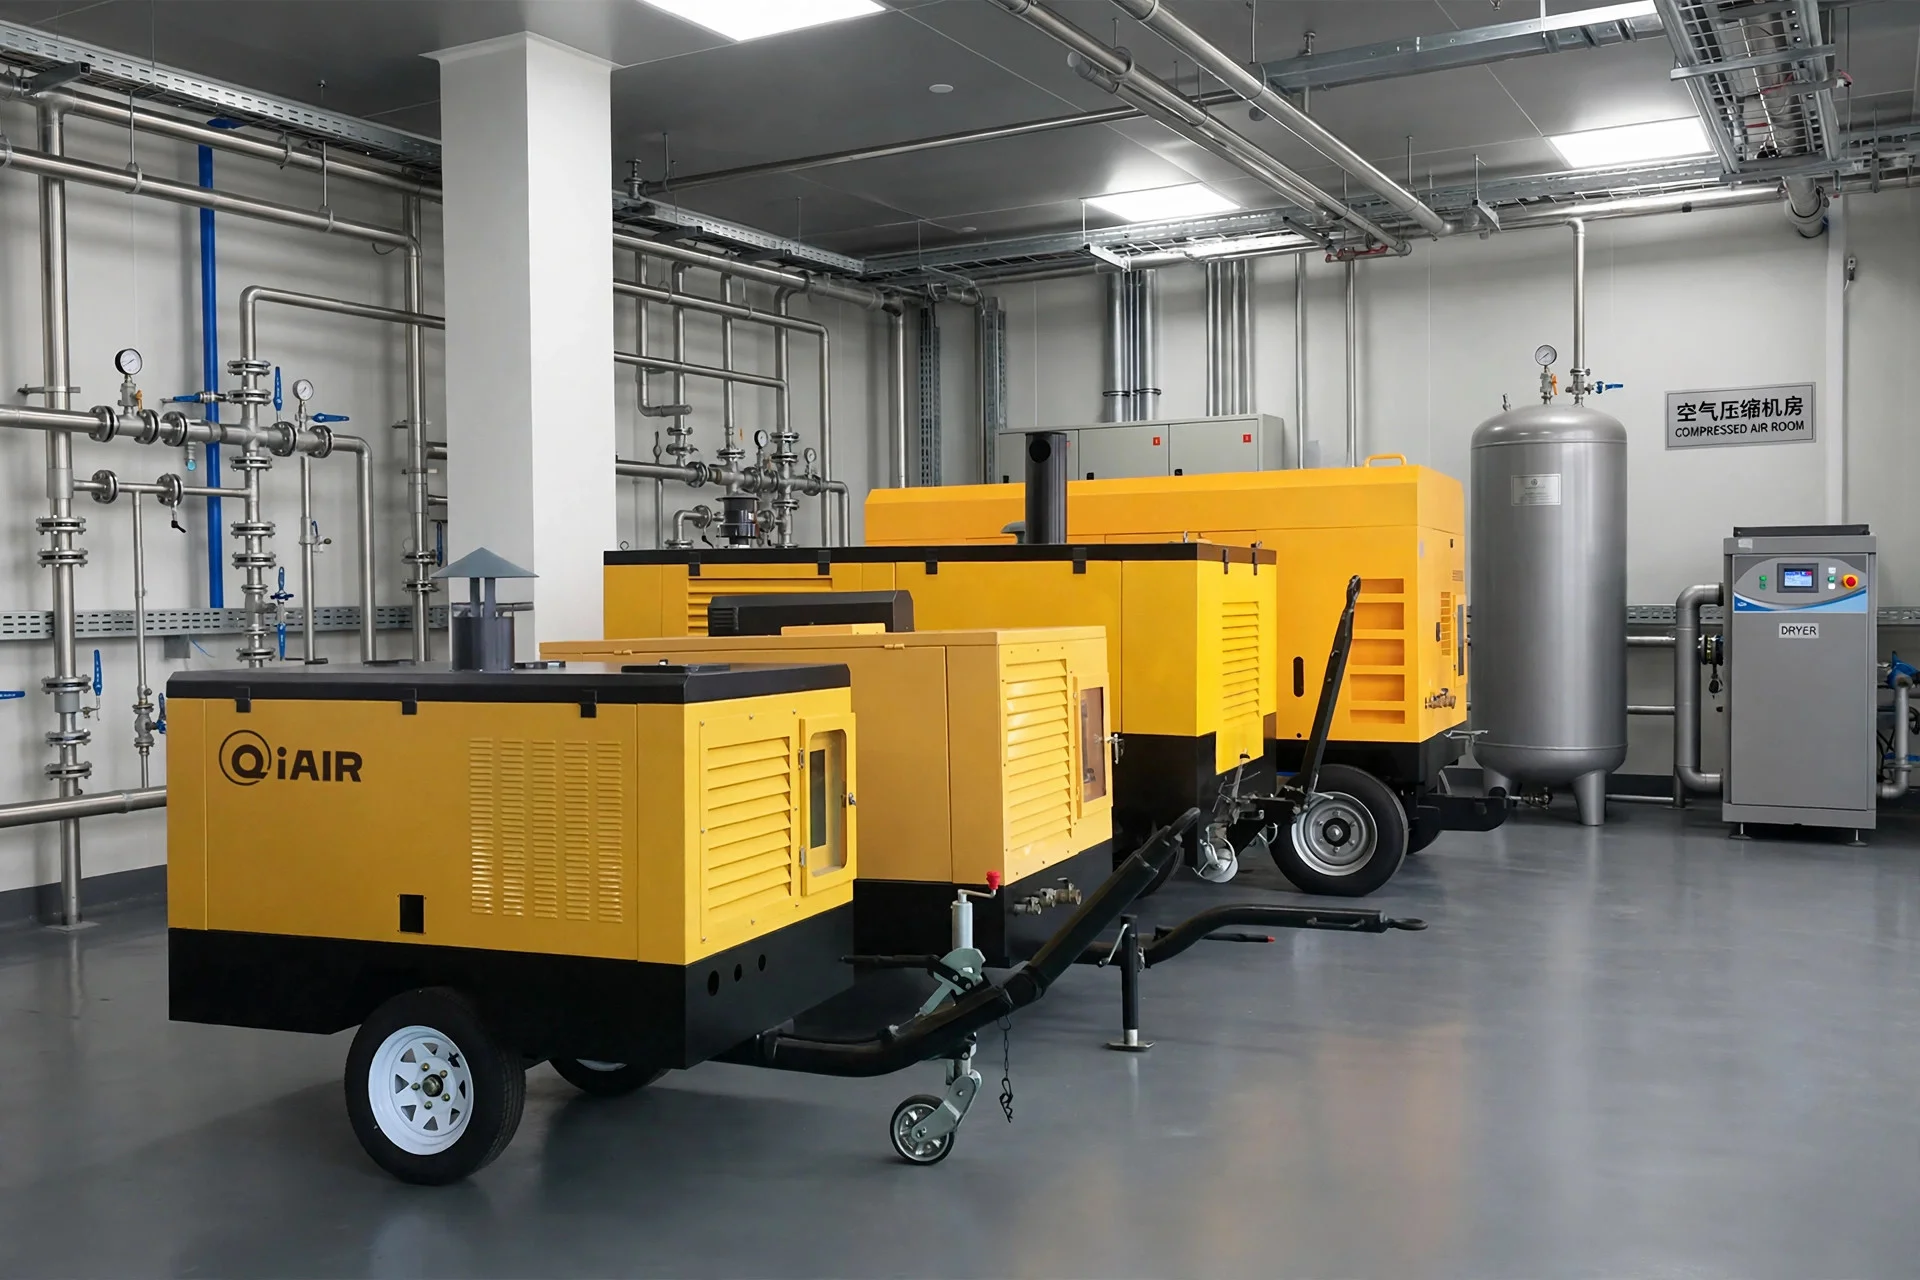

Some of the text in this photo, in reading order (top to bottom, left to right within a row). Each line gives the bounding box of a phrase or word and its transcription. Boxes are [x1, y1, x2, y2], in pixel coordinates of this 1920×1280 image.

[1676, 395, 1804, 422] 空气压缩机房
[1675, 420, 1805, 437] COMPRESSED AIR ROOM
[1781, 625, 1817, 636] DRYER
[218, 729, 363, 787] QiAIR
